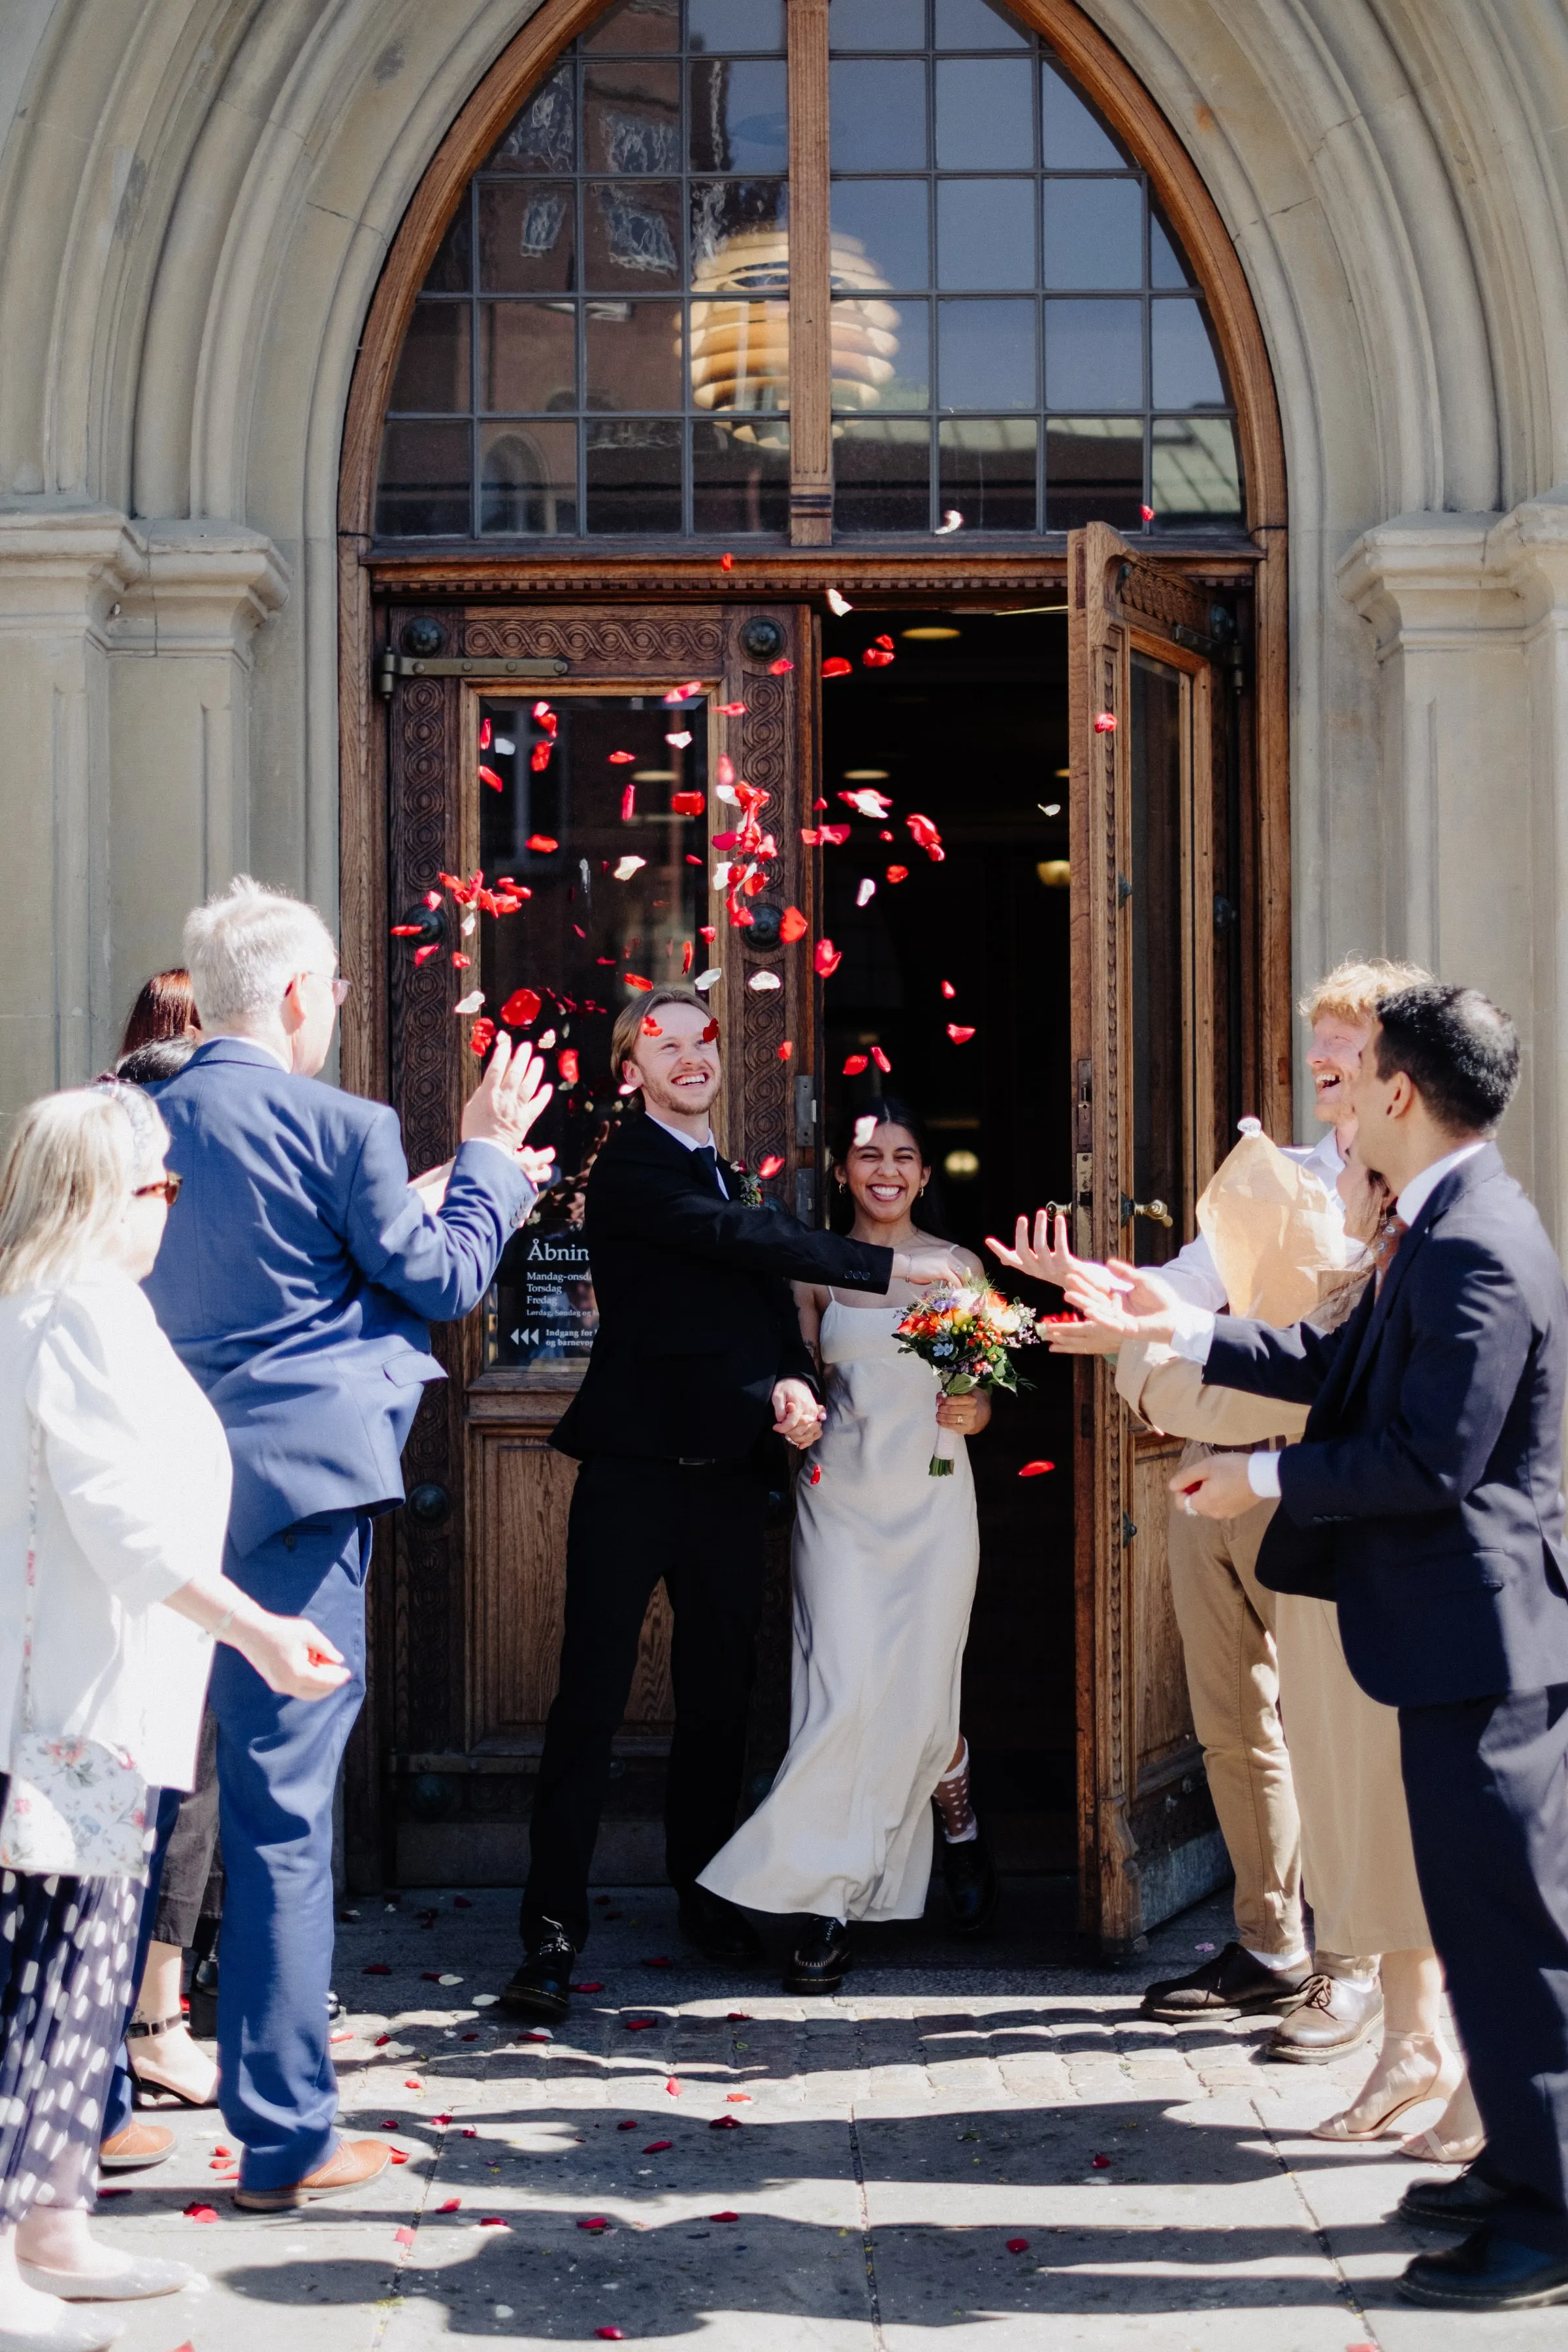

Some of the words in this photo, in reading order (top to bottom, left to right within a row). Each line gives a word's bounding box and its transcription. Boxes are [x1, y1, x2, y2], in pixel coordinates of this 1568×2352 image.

[527, 1238, 590, 1261] Åbnin
[527, 1284, 563, 1295] Torsdag
[527, 1296, 558, 1307] Fredag
[546, 1329, 580, 1338] Indgang
